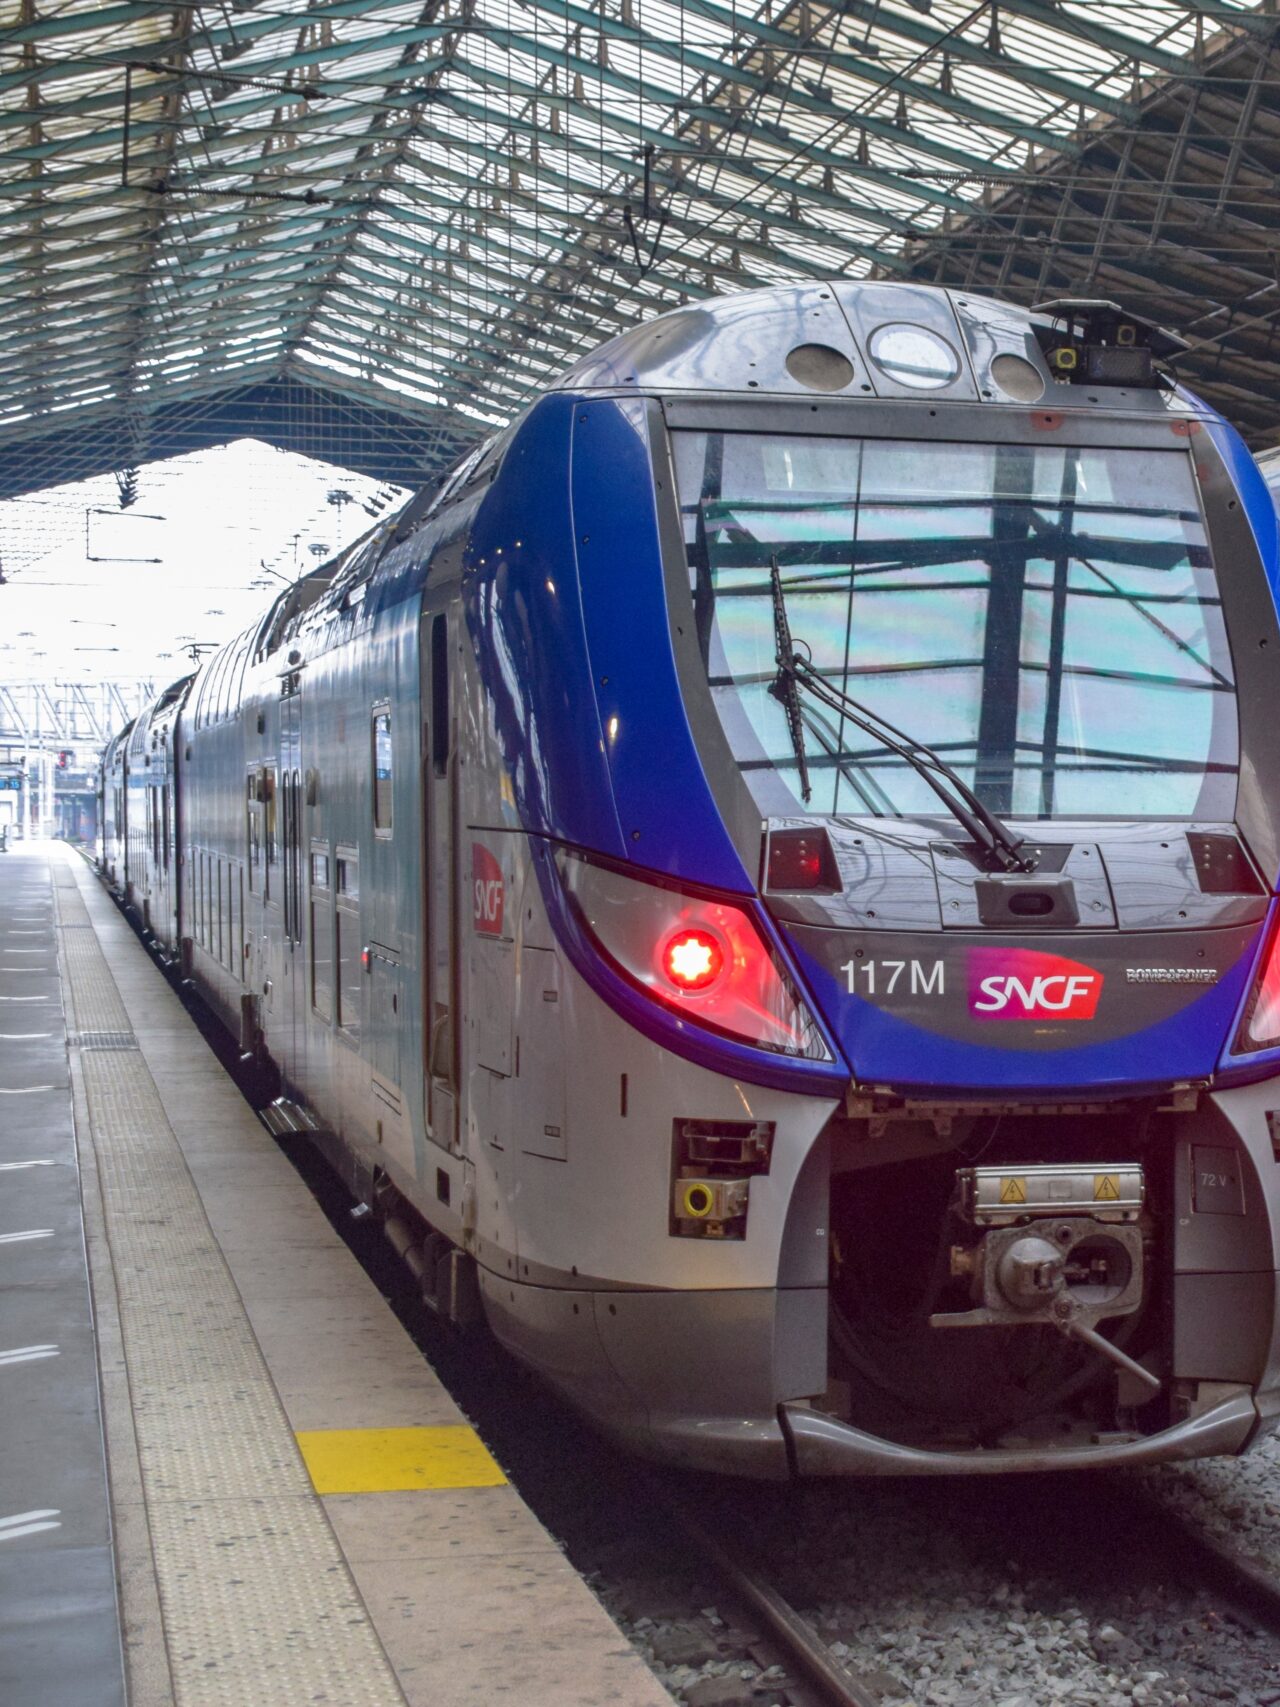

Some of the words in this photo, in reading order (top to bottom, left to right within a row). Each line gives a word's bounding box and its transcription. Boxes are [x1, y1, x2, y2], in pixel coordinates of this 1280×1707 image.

[475, 879, 503, 922] SNCF
[840, 960, 945, 994] 117M
[1126, 968, 1218, 983] BOMBARDIER
[975, 976, 1094, 1010] SNCF
[1200, 1173, 1216, 1186] 72
[1219, 1175, 1226, 1186] V
